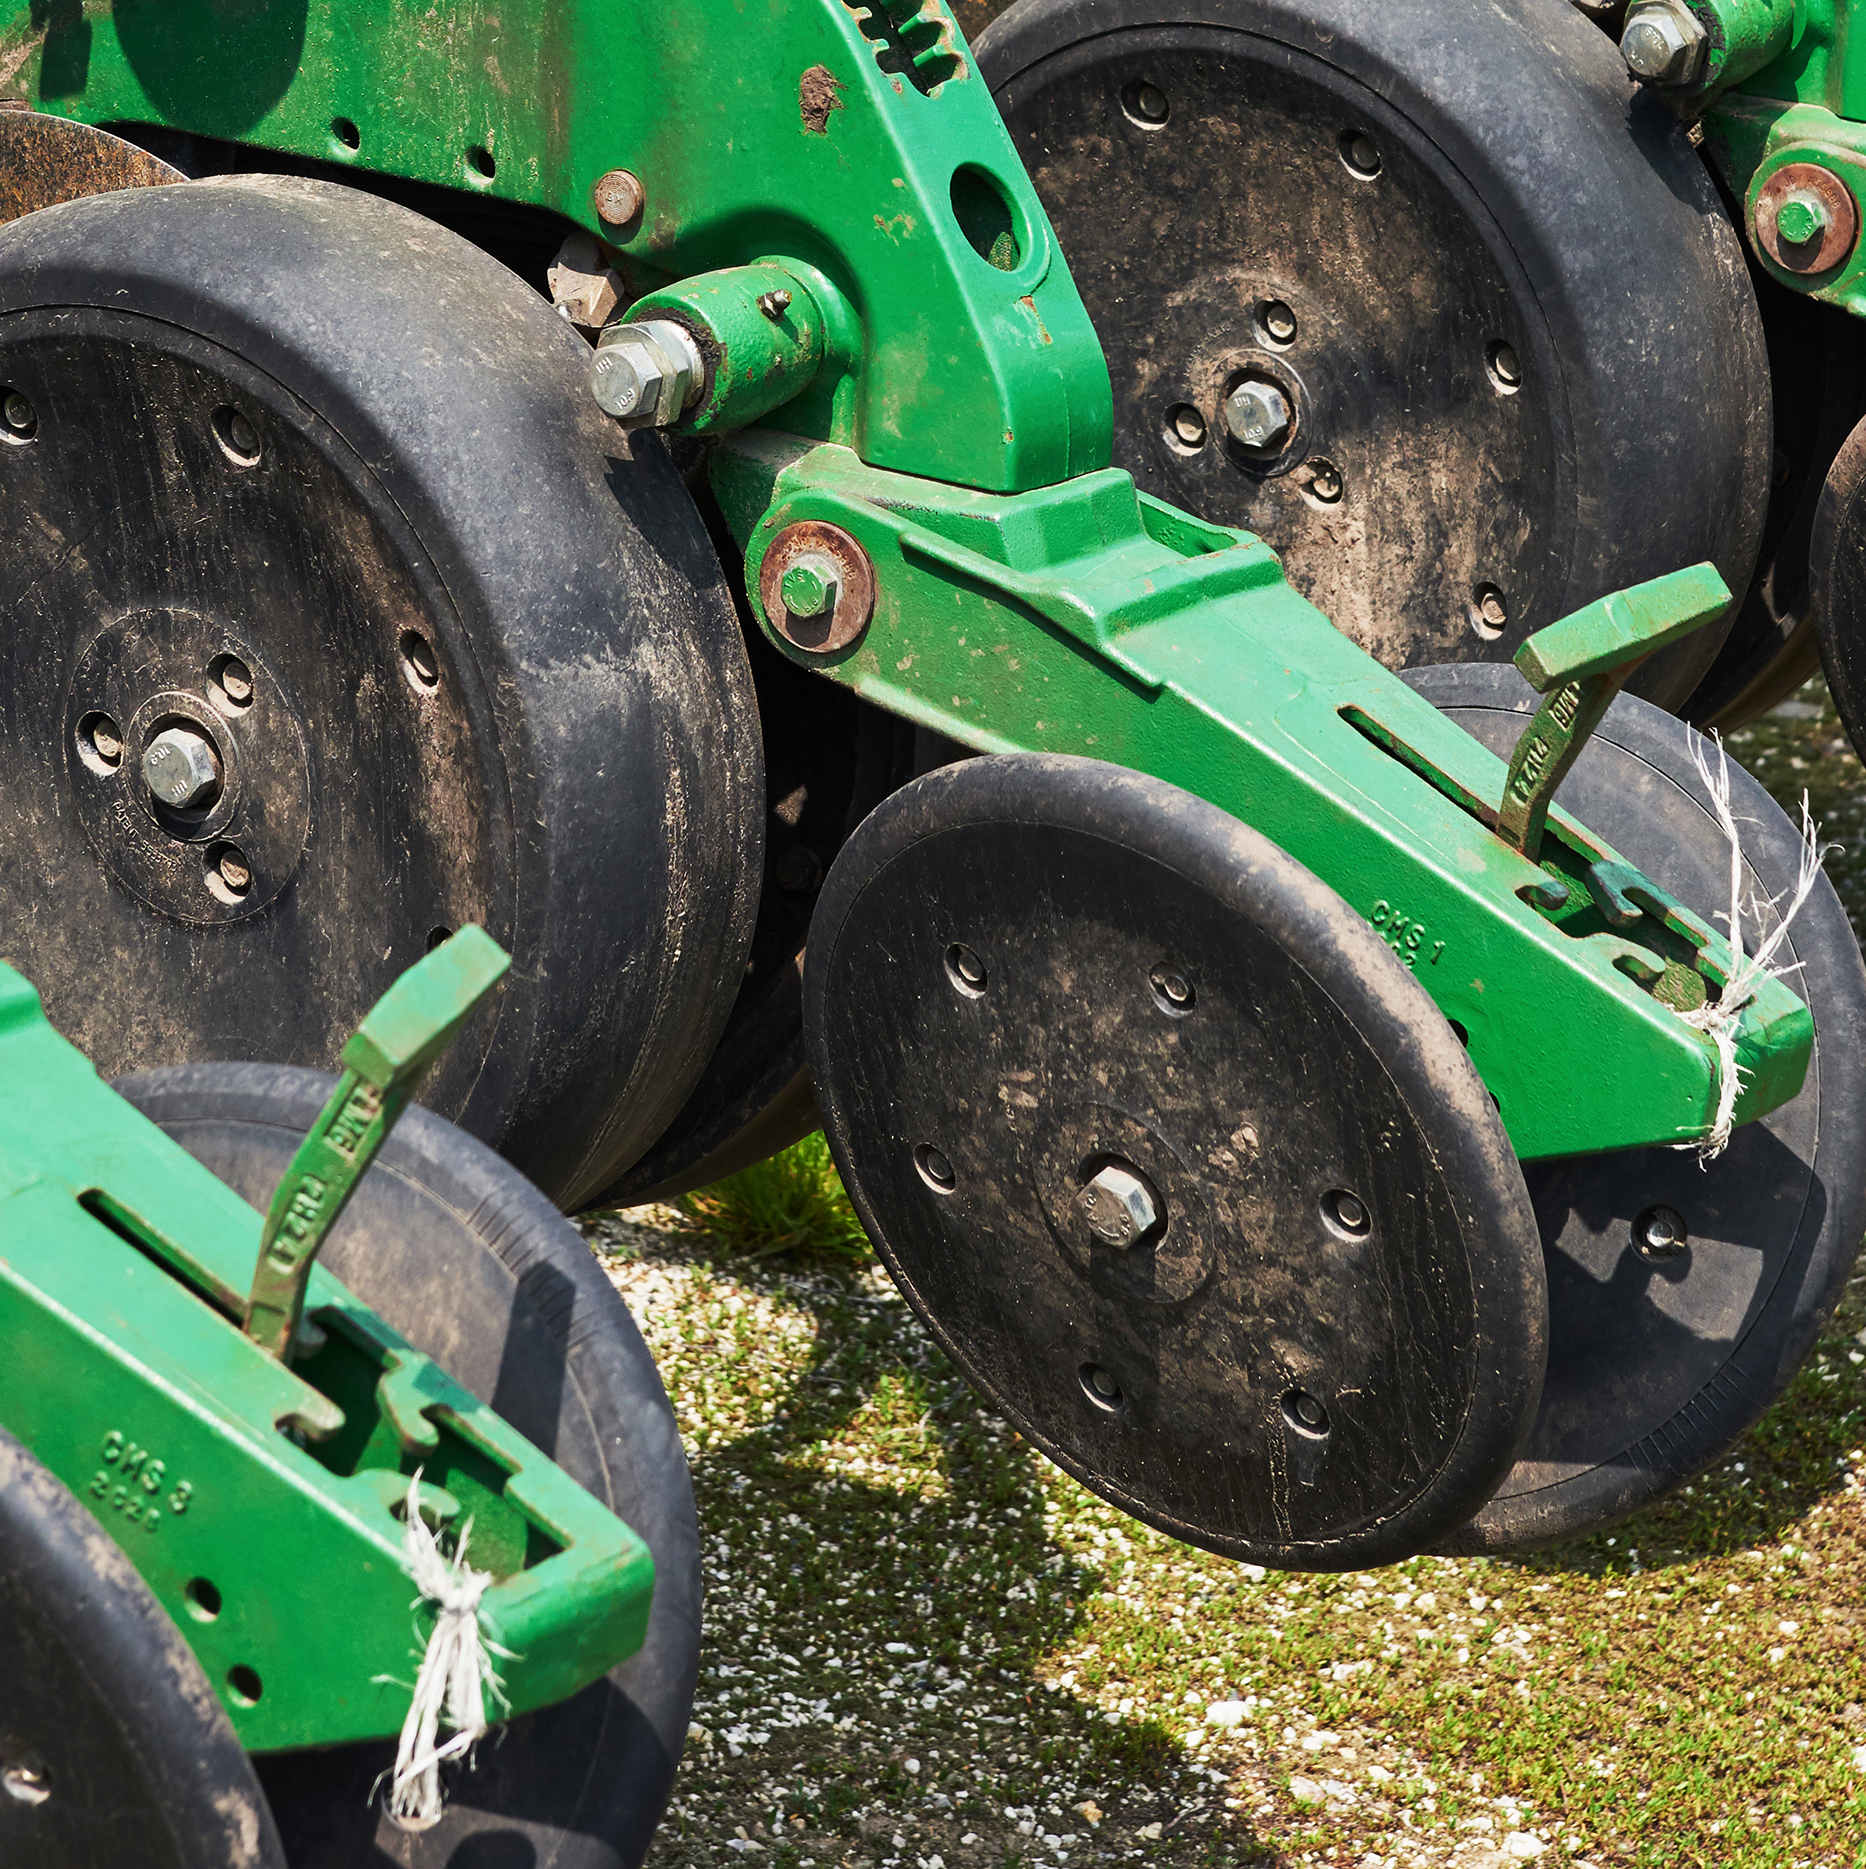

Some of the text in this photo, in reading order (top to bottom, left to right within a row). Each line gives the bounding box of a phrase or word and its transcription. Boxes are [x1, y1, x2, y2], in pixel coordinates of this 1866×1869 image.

[595, 356, 613, 375] UH
[615, 387, 636, 411] 10.9
[1371, 899, 1426, 951] CMS
[1429, 940, 1446, 965] 1
